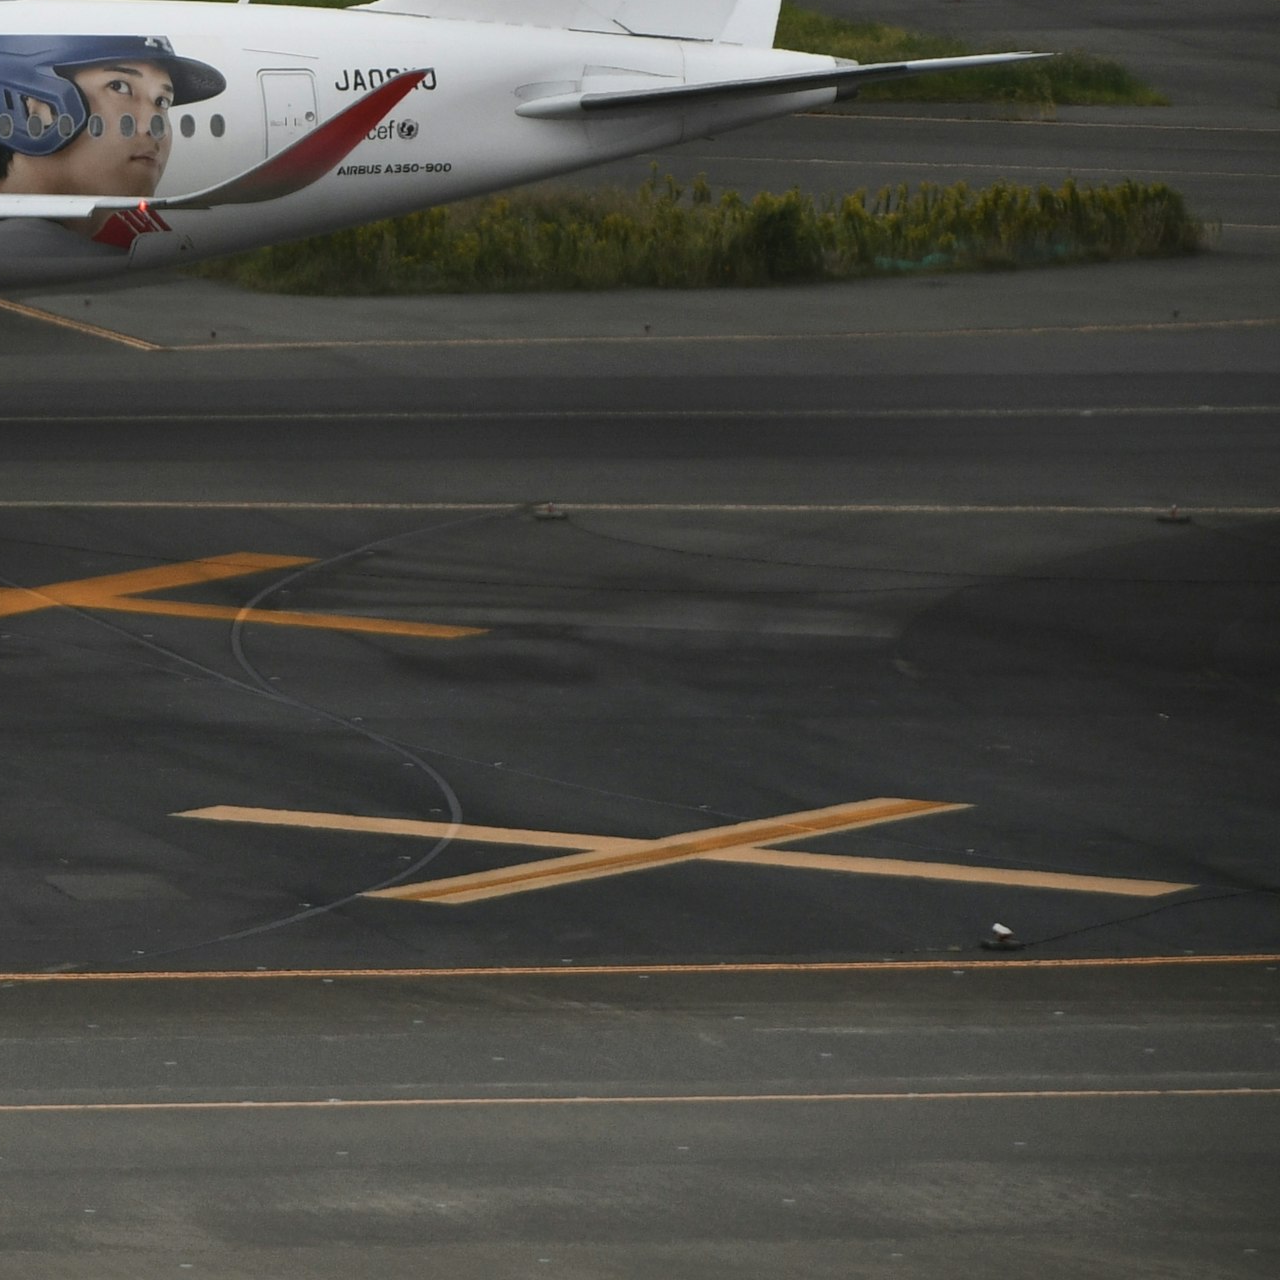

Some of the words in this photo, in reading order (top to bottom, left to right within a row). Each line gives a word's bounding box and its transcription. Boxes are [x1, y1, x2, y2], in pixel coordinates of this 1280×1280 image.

[335, 67, 437, 91] JA0J
[337, 164, 382, 176] AIRBUS
[384, 162, 452, 174] A350-900
